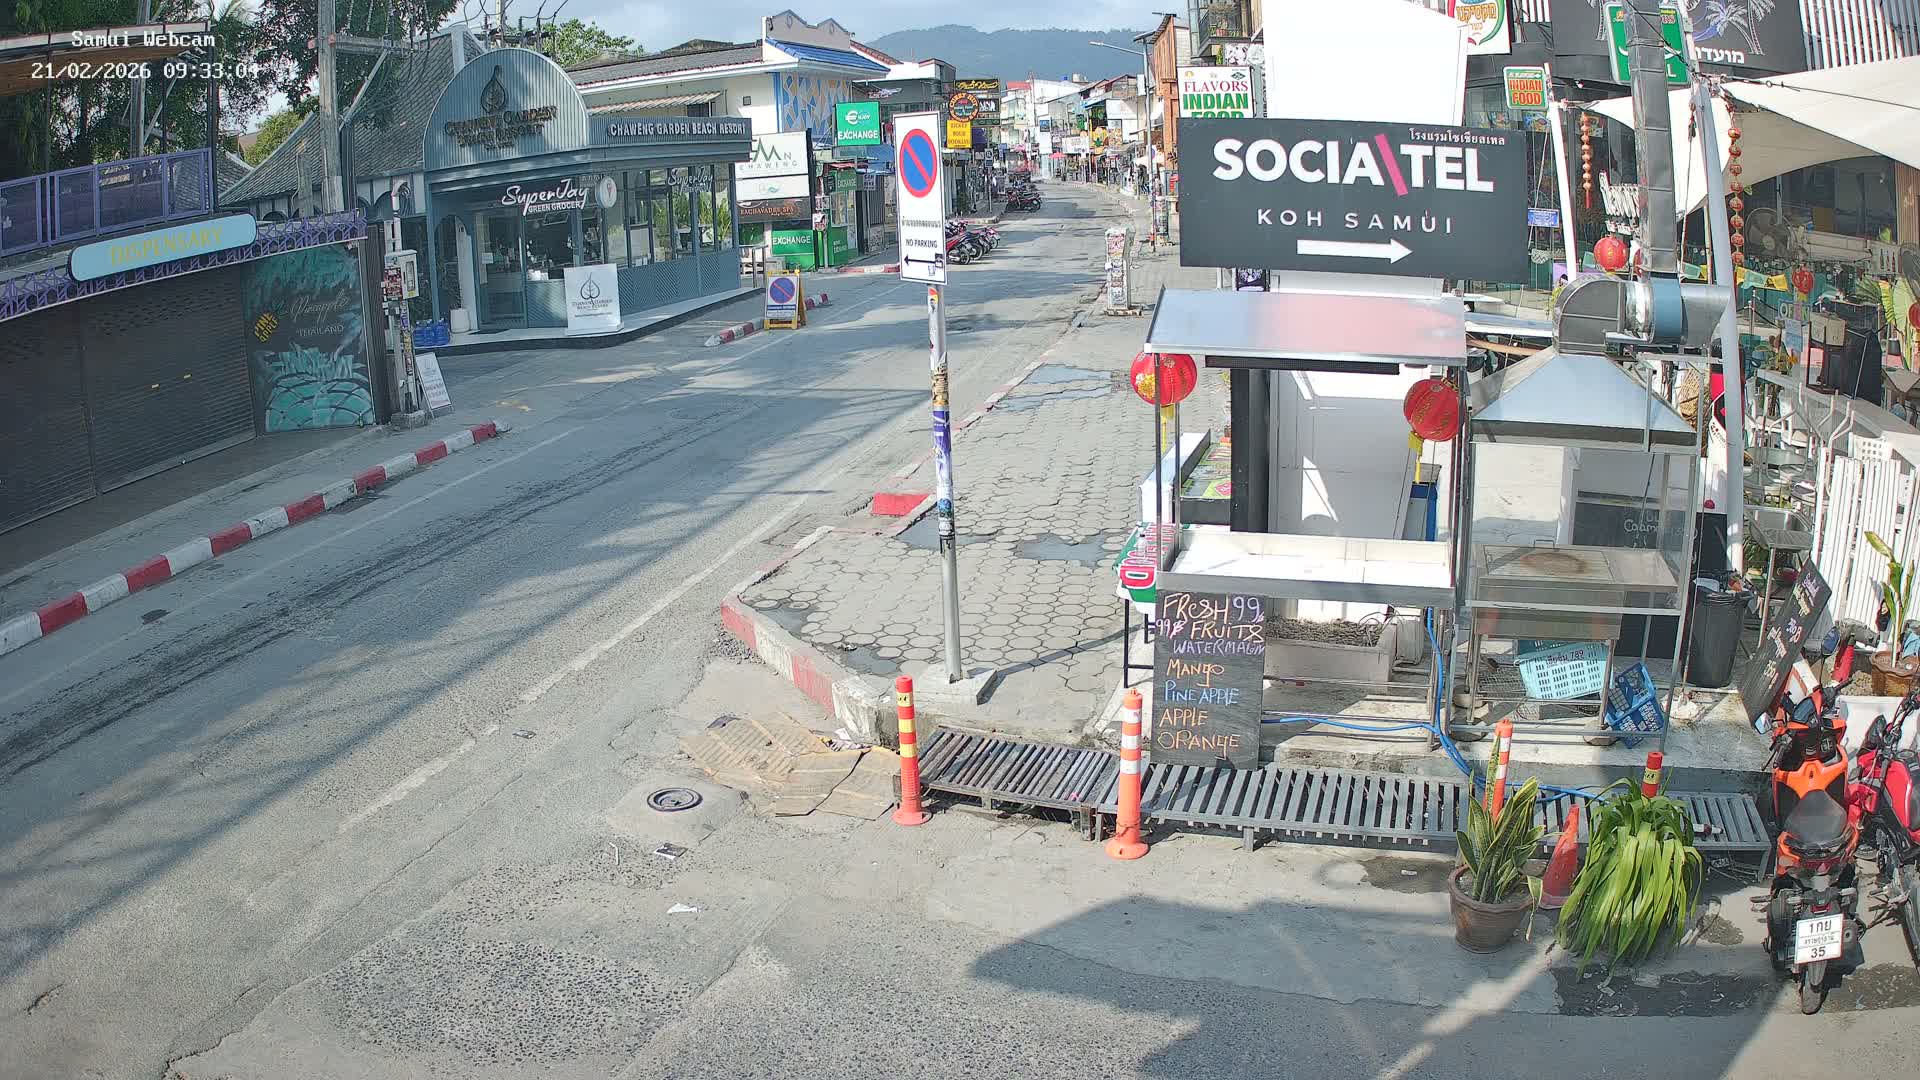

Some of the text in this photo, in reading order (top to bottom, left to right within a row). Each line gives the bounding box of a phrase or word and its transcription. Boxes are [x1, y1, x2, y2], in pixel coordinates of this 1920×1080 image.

[1184, 81, 1249, 92] FLAVORS
[1509, 79, 1542, 91] INDIAN
[1183, 93, 1249, 110] INDIAN
[1512, 92, 1542, 105] FOOD
[609, 122, 654, 136] CHAWENG
[656, 122, 690, 136] GARDEN
[692, 122, 717, 135] BEACH
[838, 130, 879, 140] EXCHANGE
[501, 178, 589, 216] SuperJay
[528, 201, 582, 213] GREEN GROCER
[1257, 208, 1451, 234] KOH SAMUI
[772, 235, 811, 244] EXCHANGE
[906, 238, 938, 248] NO PARKING
[111, 226, 223, 267] DISPENSARY
[1570, 649, 1584, 660] 789
[1159, 706, 1208, 728] APPLE
[1811, 945, 1827, 958] 35
